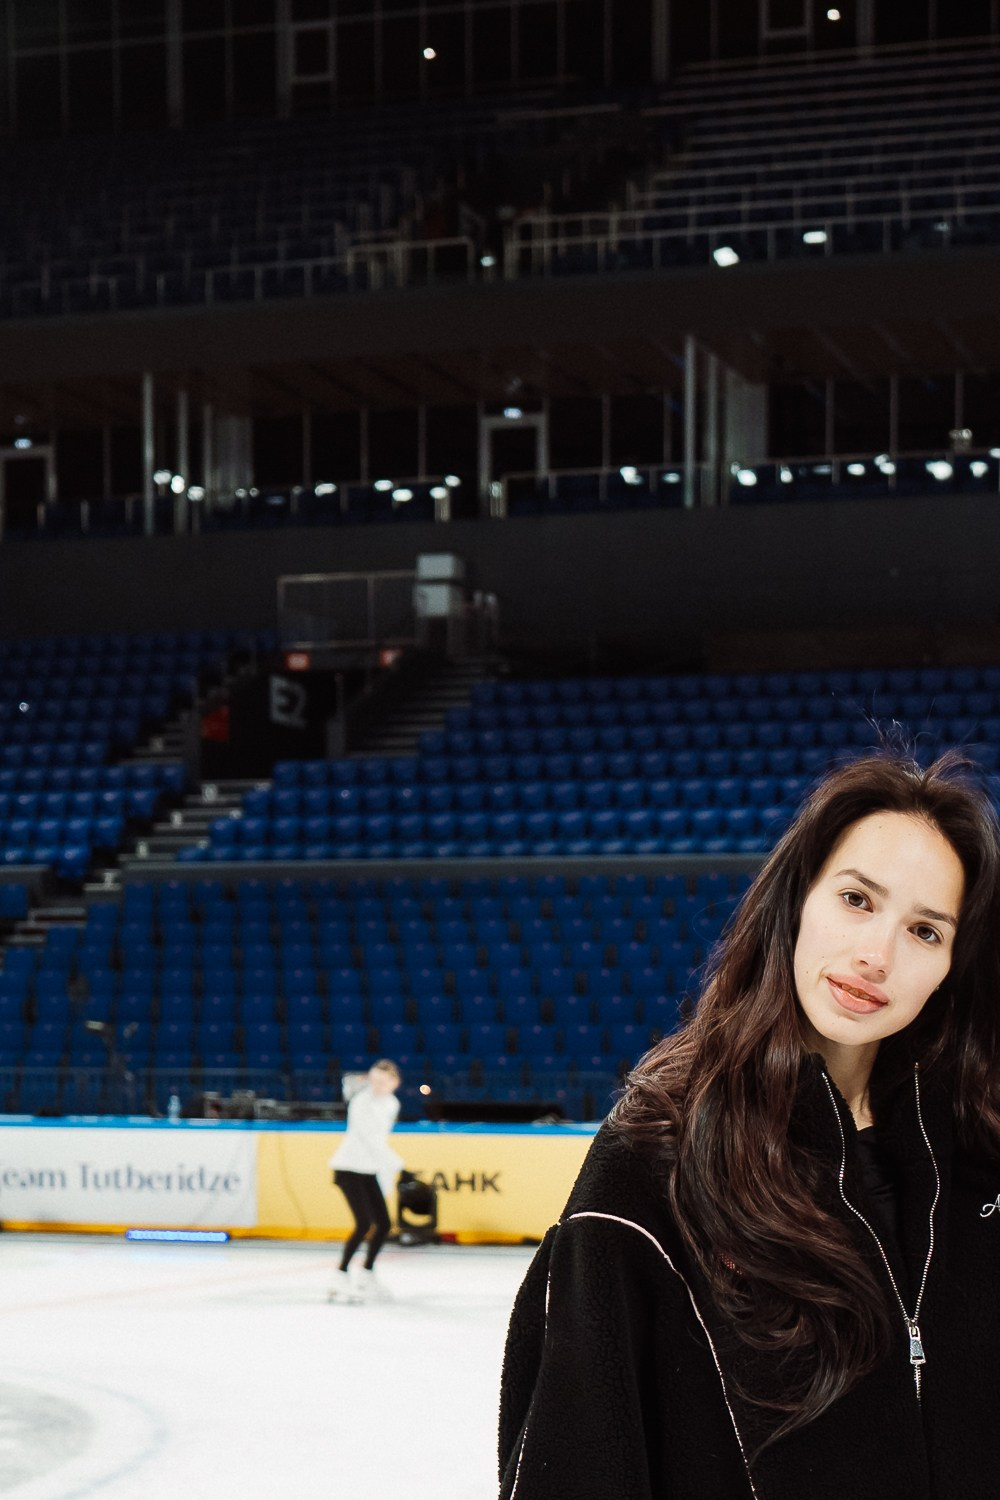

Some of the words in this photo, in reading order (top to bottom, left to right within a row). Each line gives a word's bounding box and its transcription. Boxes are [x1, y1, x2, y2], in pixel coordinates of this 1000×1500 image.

[0, 1165, 67, 1190] eam
[77, 1162, 241, 1192] Tutberidze
[410, 1170, 501, 1193] АНК
